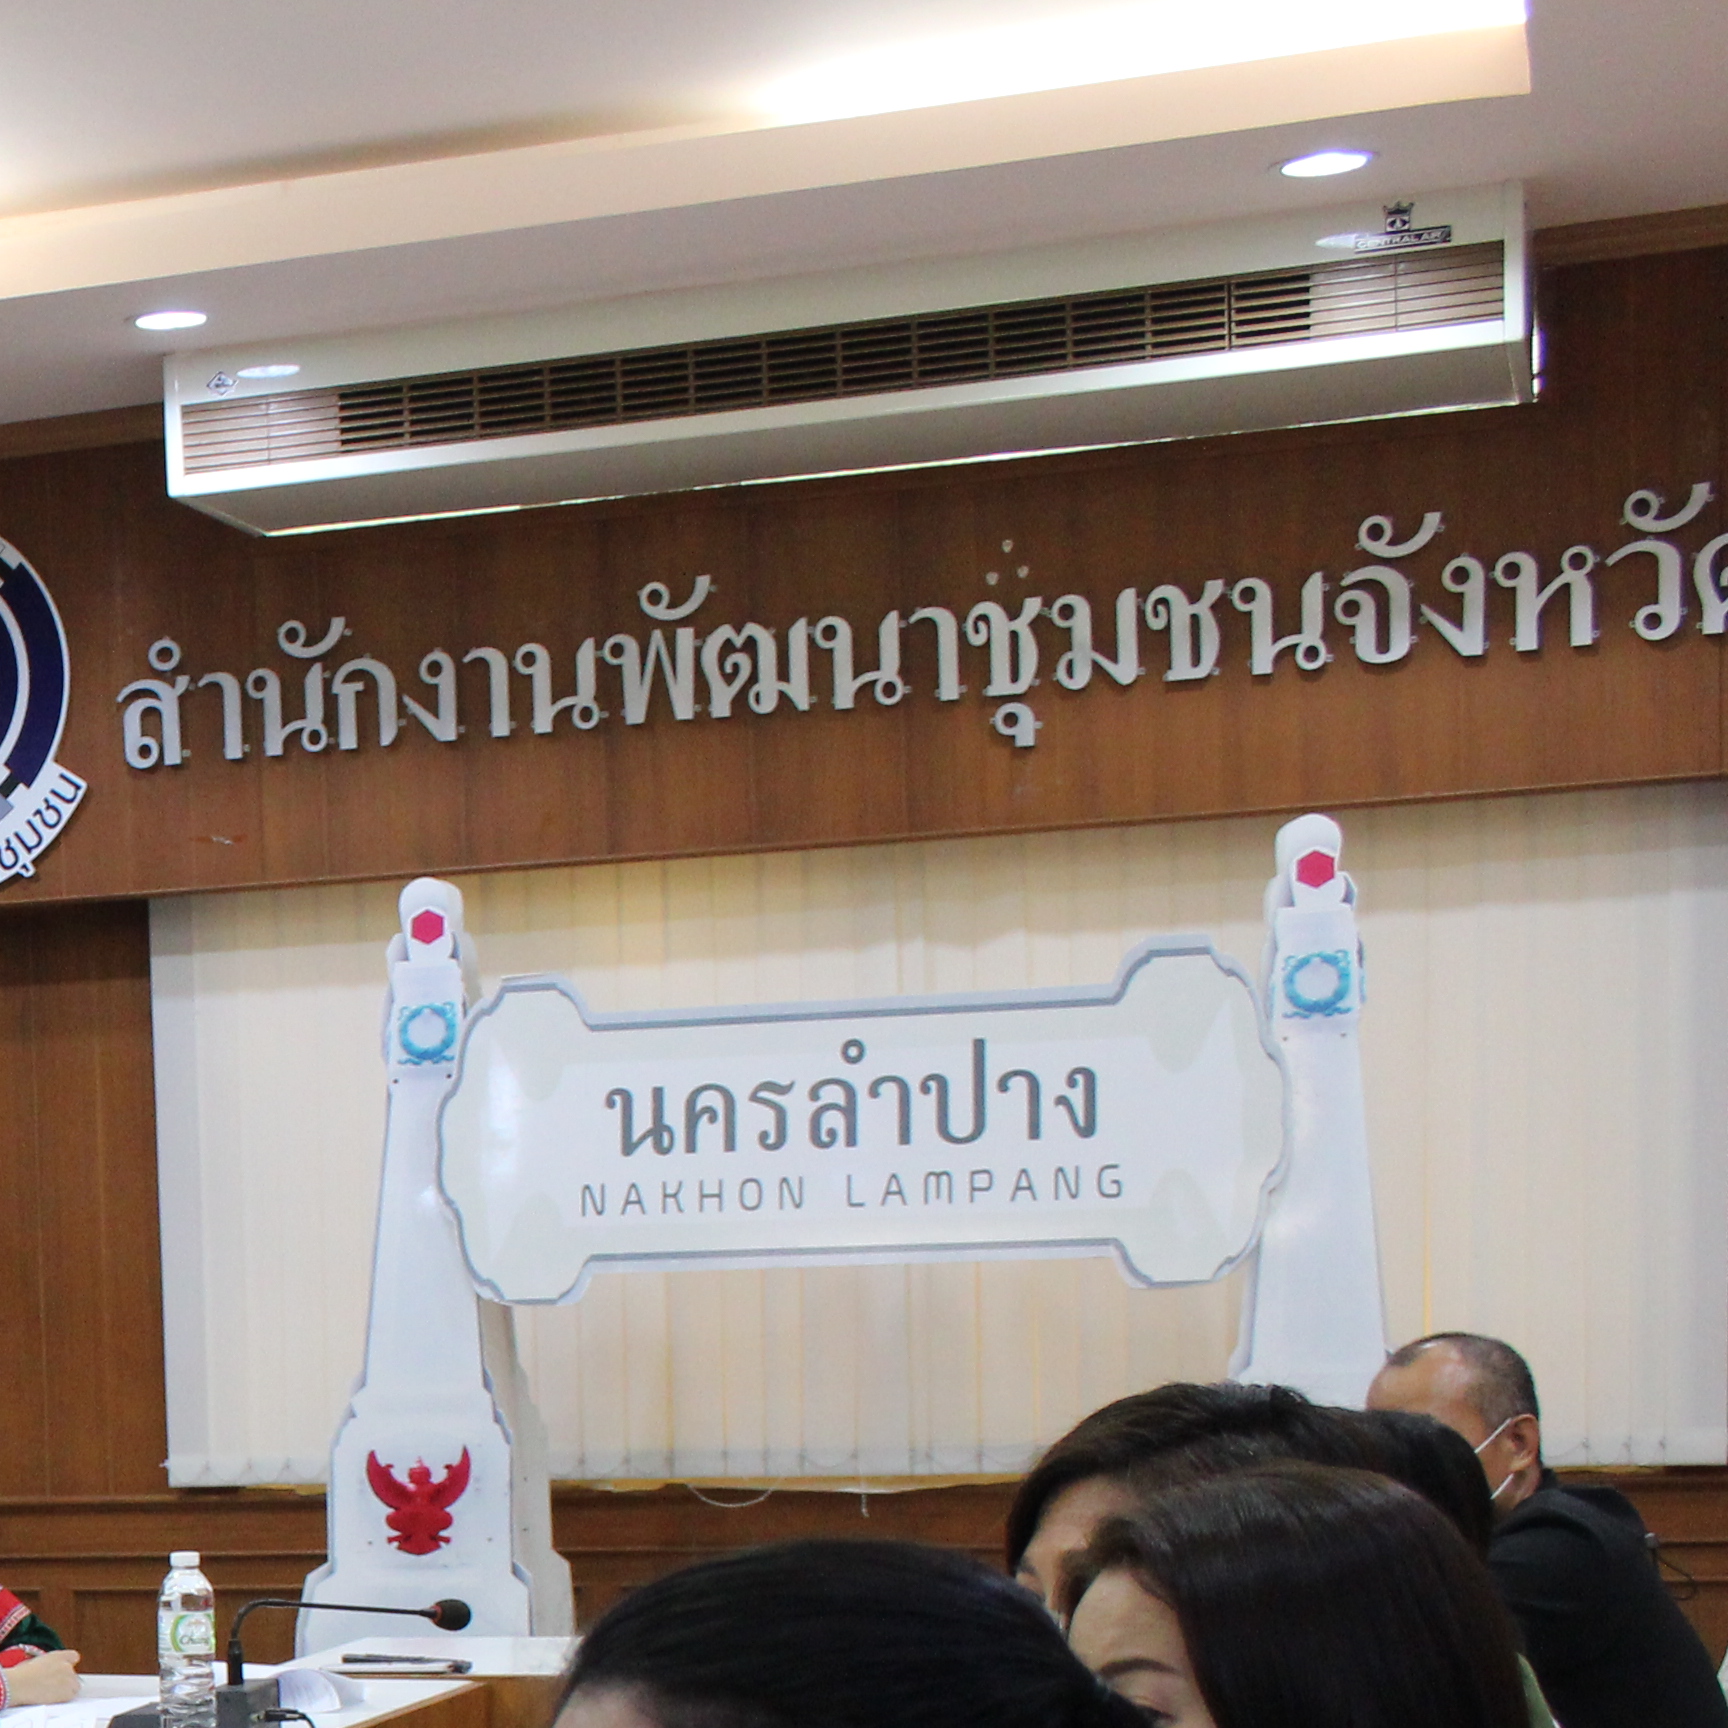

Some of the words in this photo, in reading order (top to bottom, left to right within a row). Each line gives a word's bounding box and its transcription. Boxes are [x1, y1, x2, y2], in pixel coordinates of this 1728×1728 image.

[604, 1037, 1098, 1157] นครลำปาง
[579, 1173, 807, 1218] NAKHON
[845, 1163, 1126, 1209] LAMPANG
